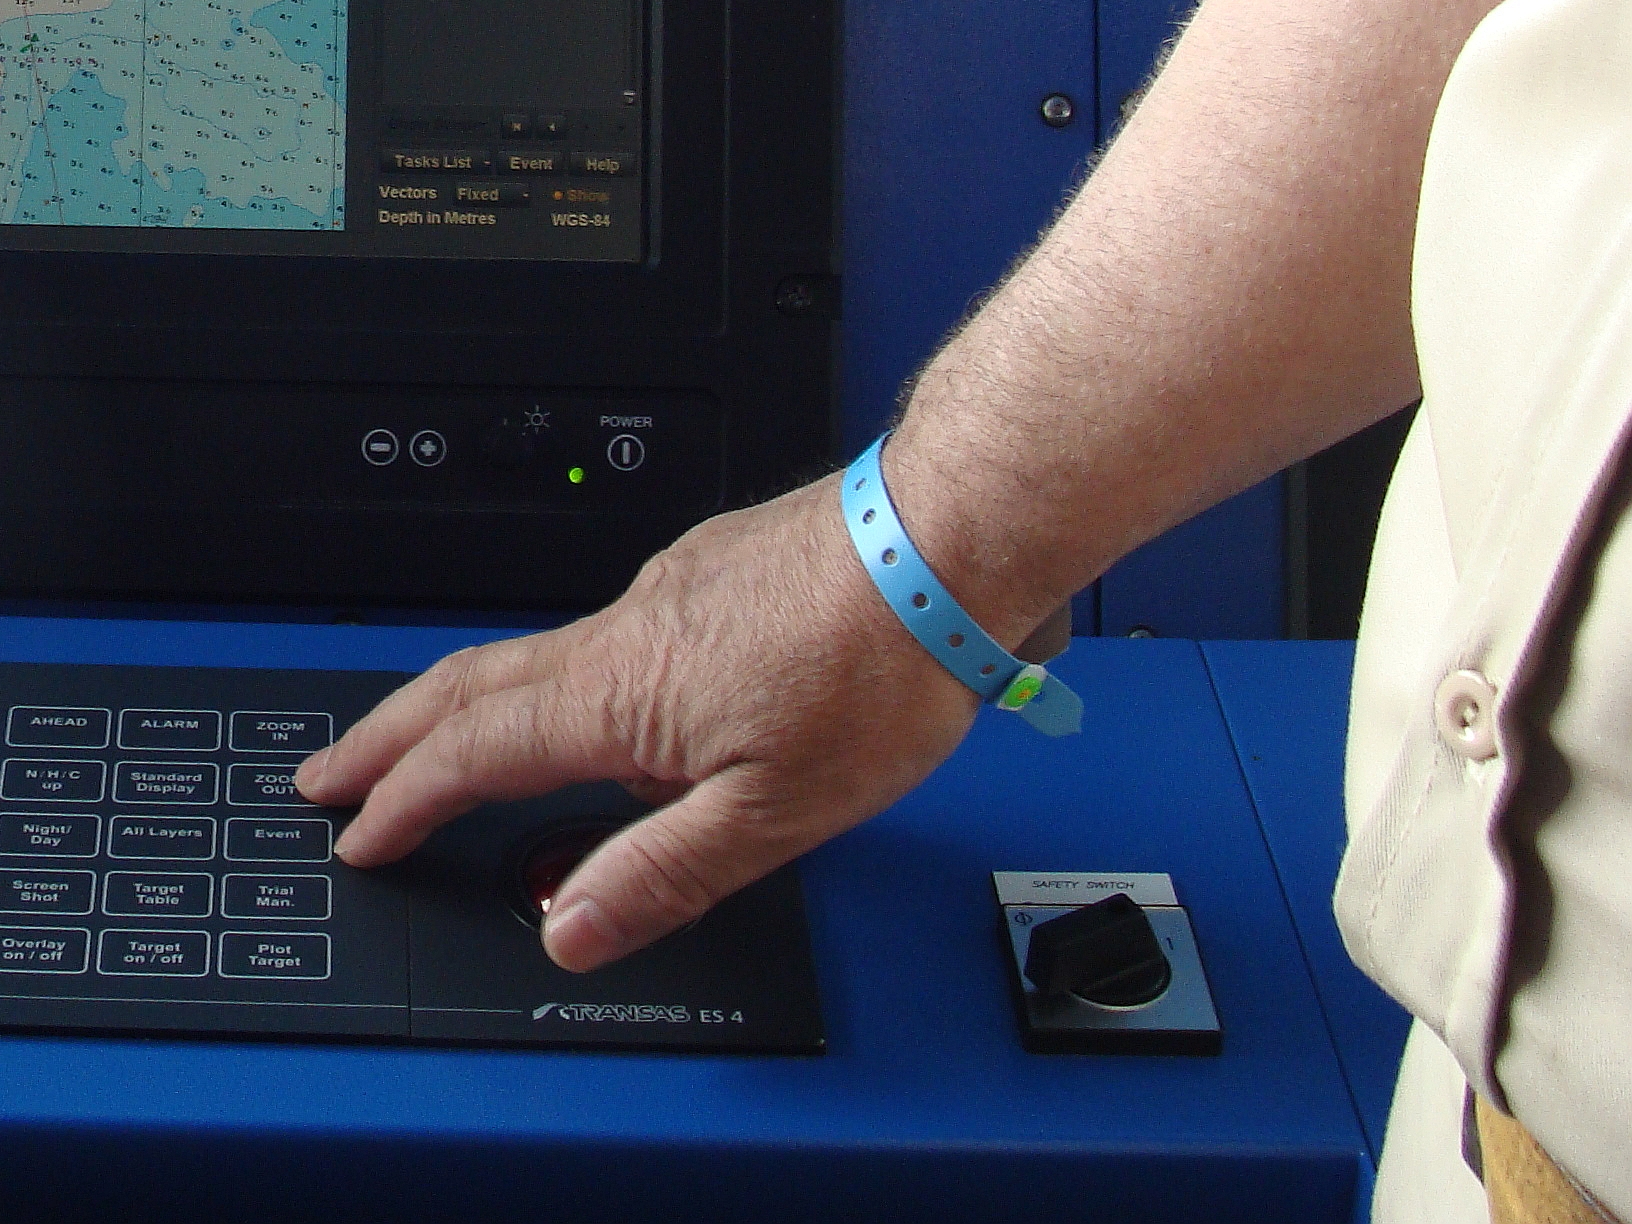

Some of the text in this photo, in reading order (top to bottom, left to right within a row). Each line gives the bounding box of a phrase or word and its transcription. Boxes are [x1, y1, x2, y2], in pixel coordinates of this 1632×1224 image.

[395, 155, 620, 173] Tasks List Event Help
[378, 186, 499, 201] Vectors Fixed
[378, 210, 611, 227] Depth in Metres WGS-84
[600, 415, 653, 428] POWER
[30, 716, 88, 728] AHEAD
[140, 718, 200, 730] ALARM
[256, 721, 305, 732] ZOOM
[272, 732, 289, 741] IN
[130, 772, 203, 783] Standard
[42, 781, 63, 792] up
[136, 782, 196, 795] Display
[262, 785, 297, 795] OUT
[121, 827, 203, 839] All Layers
[254, 829, 302, 840] Event
[31, 836, 62, 847] Day
[12, 880, 69, 891] Screen
[133, 883, 184, 895] Target
[1032, 880, 1136, 890] SAFETY SWITCH
[258, 886, 294, 896] Trial
[20, 892, 60, 902] Shot
[137, 895, 180, 906] Table
[256, 897, 295, 907] Man.
[1, 938, 67, 951] Overlay
[128, 941, 181, 954] Target
[258, 944, 292, 955] Plot
[249, 956, 302, 968] Target
[569, 1004, 744, 1024] TRANSAS ES 4
